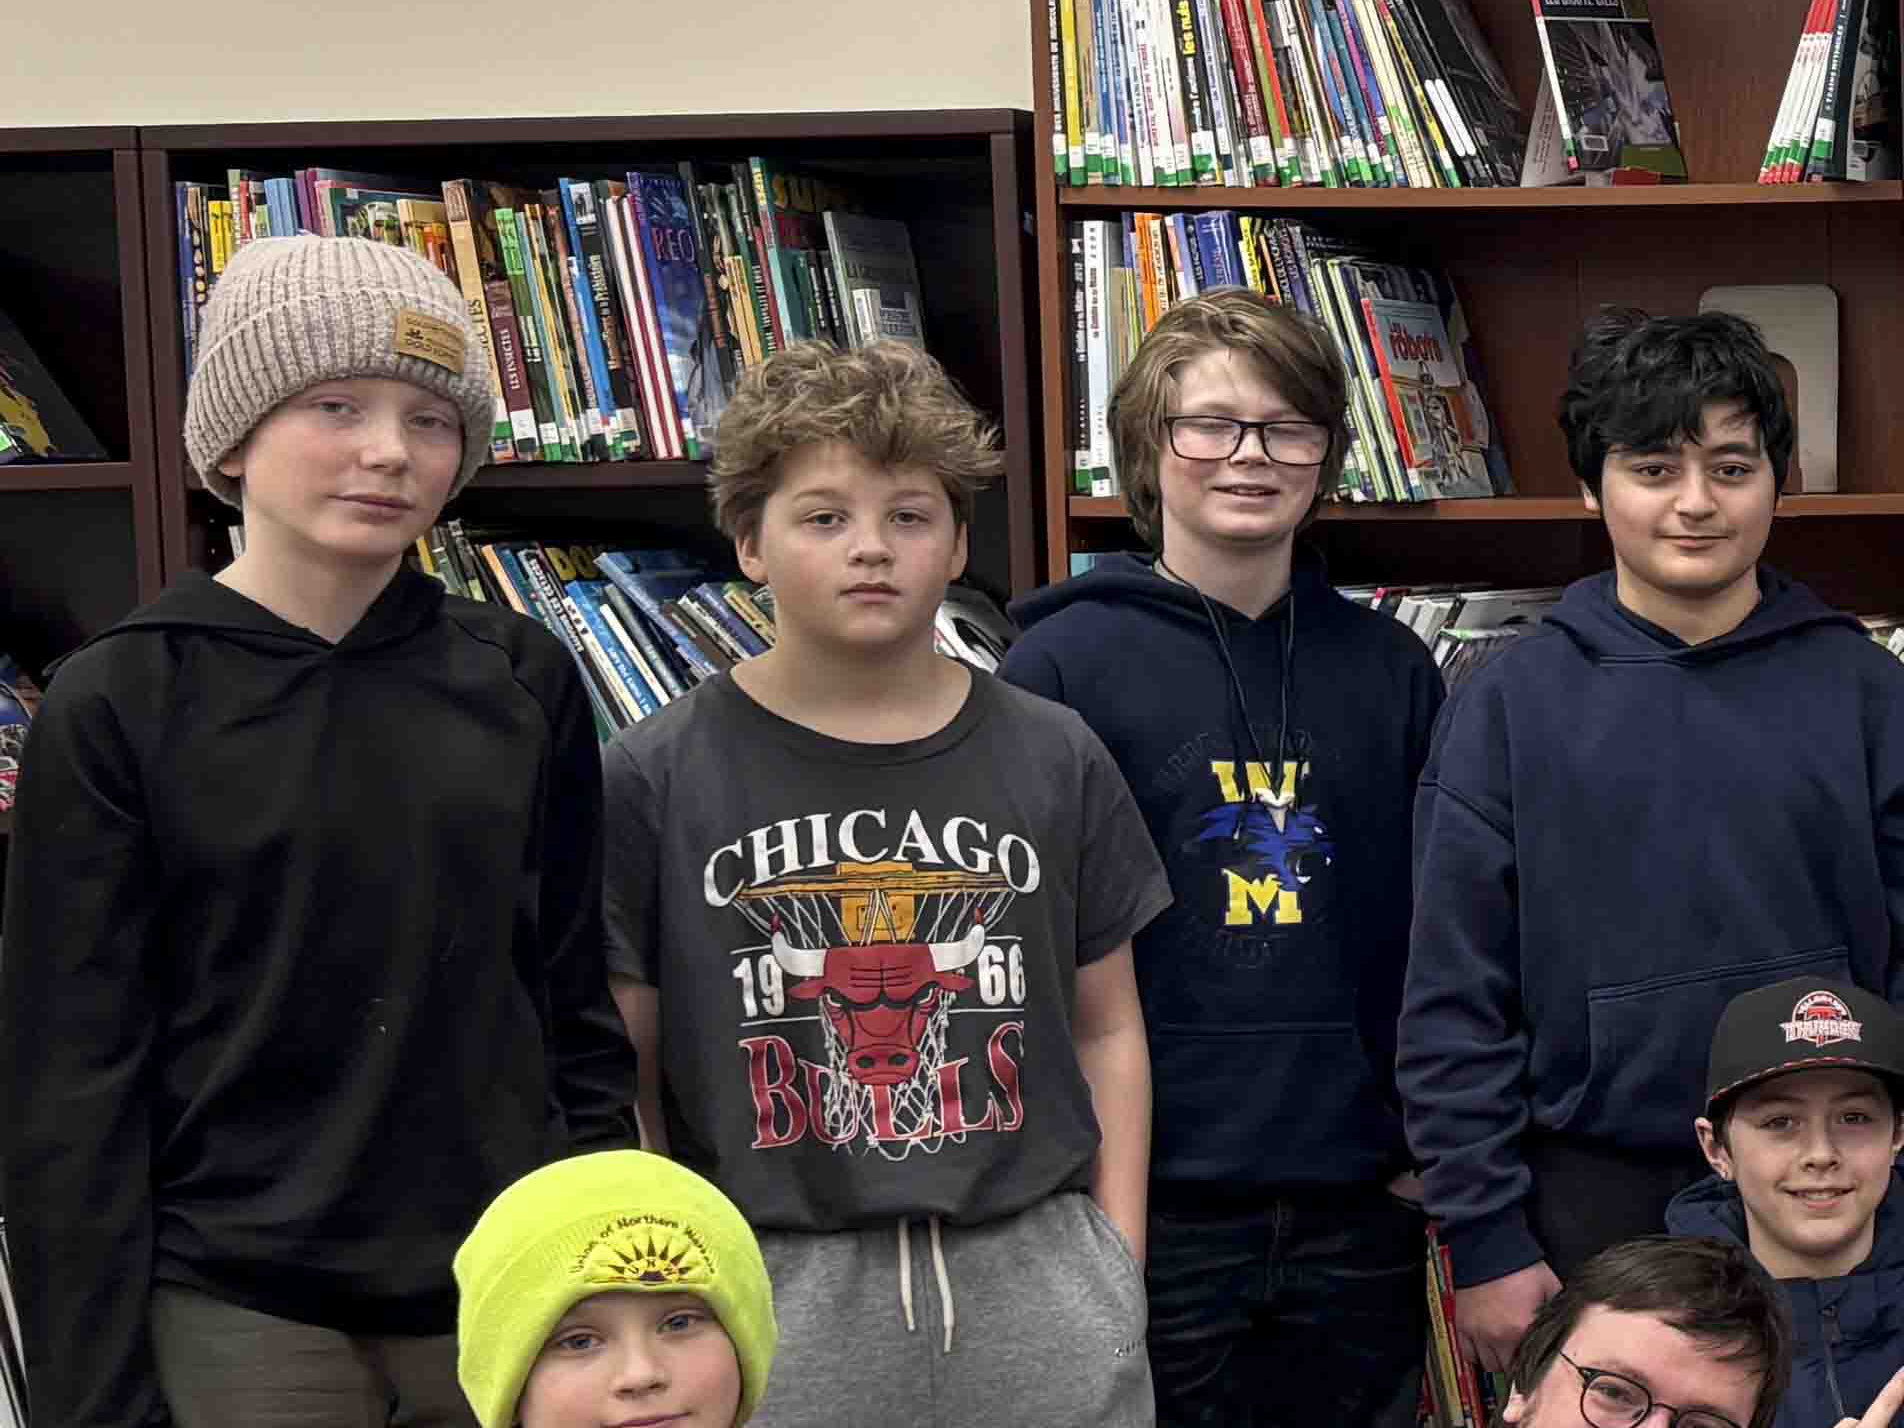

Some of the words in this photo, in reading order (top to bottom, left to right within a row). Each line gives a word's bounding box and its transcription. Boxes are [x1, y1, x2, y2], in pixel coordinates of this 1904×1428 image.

[1180, 28, 1198, 54] les
[702, 809, 1042, 907] CHICAGO
[731, 954, 787, 1020] 19
[977, 940, 1027, 1007] 66
[739, 1019, 1026, 1150] BULLS
[616, 1214, 679, 1229] Northern
